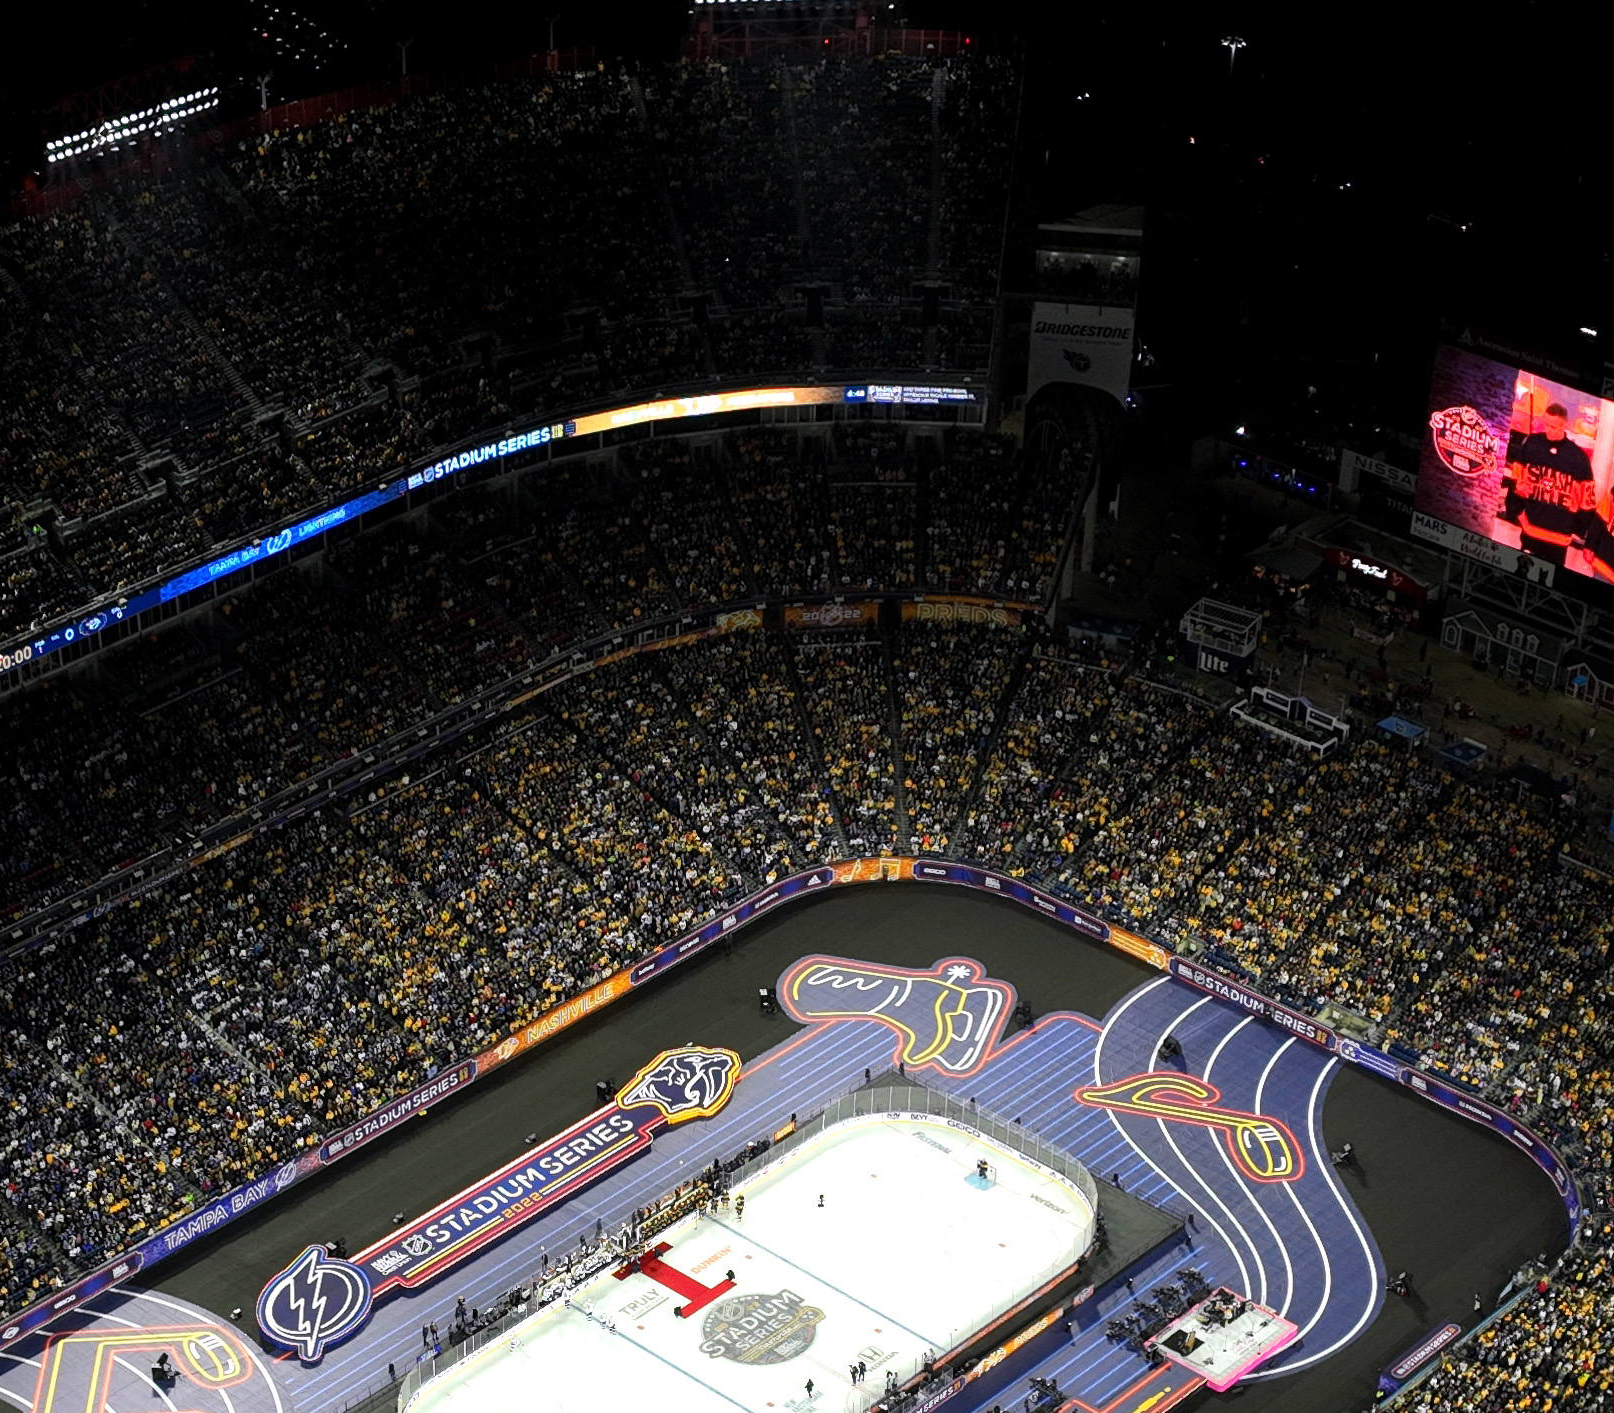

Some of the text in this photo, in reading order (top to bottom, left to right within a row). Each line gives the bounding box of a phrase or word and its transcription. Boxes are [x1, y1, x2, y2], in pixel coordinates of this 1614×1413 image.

[1035, 321, 1131, 339] BRIDGESTONE
[1434, 413, 1498, 454] STADIUM SERIES
[435, 444, 497, 479] STADIUM
[498, 428, 550, 456] SERIES
[1355, 456, 1412, 484] NISSA
[1415, 513, 1447, 535] MARS
[916, 603, 1008, 628] PREDS
[1199, 651, 1229, 674] Lite
[527, 982, 615, 1043] NASHVILLE
[1205, 977, 1264, 1014] STADIUM
[1267, 1004, 1315, 1038] ERIES
[355, 1073, 458, 1141] STADIUM SERIES
[947, 1119, 981, 1138] GEICO
[426, 1115, 633, 1243] STADIUM SERIES
[165, 1179, 268, 1250] TAMPA BAY
[502, 1192, 542, 1219] 2022
[1030, 1193, 1067, 1215] verizon
[691, 1246, 731, 1274] DUNKIN'
[619, 1288, 659, 1315] TRULY
[700, 1289, 799, 1358] STADIUM SERIES
[869, 1352, 898, 1372] HONDA
[923, 1389, 954, 1411] SERIES
